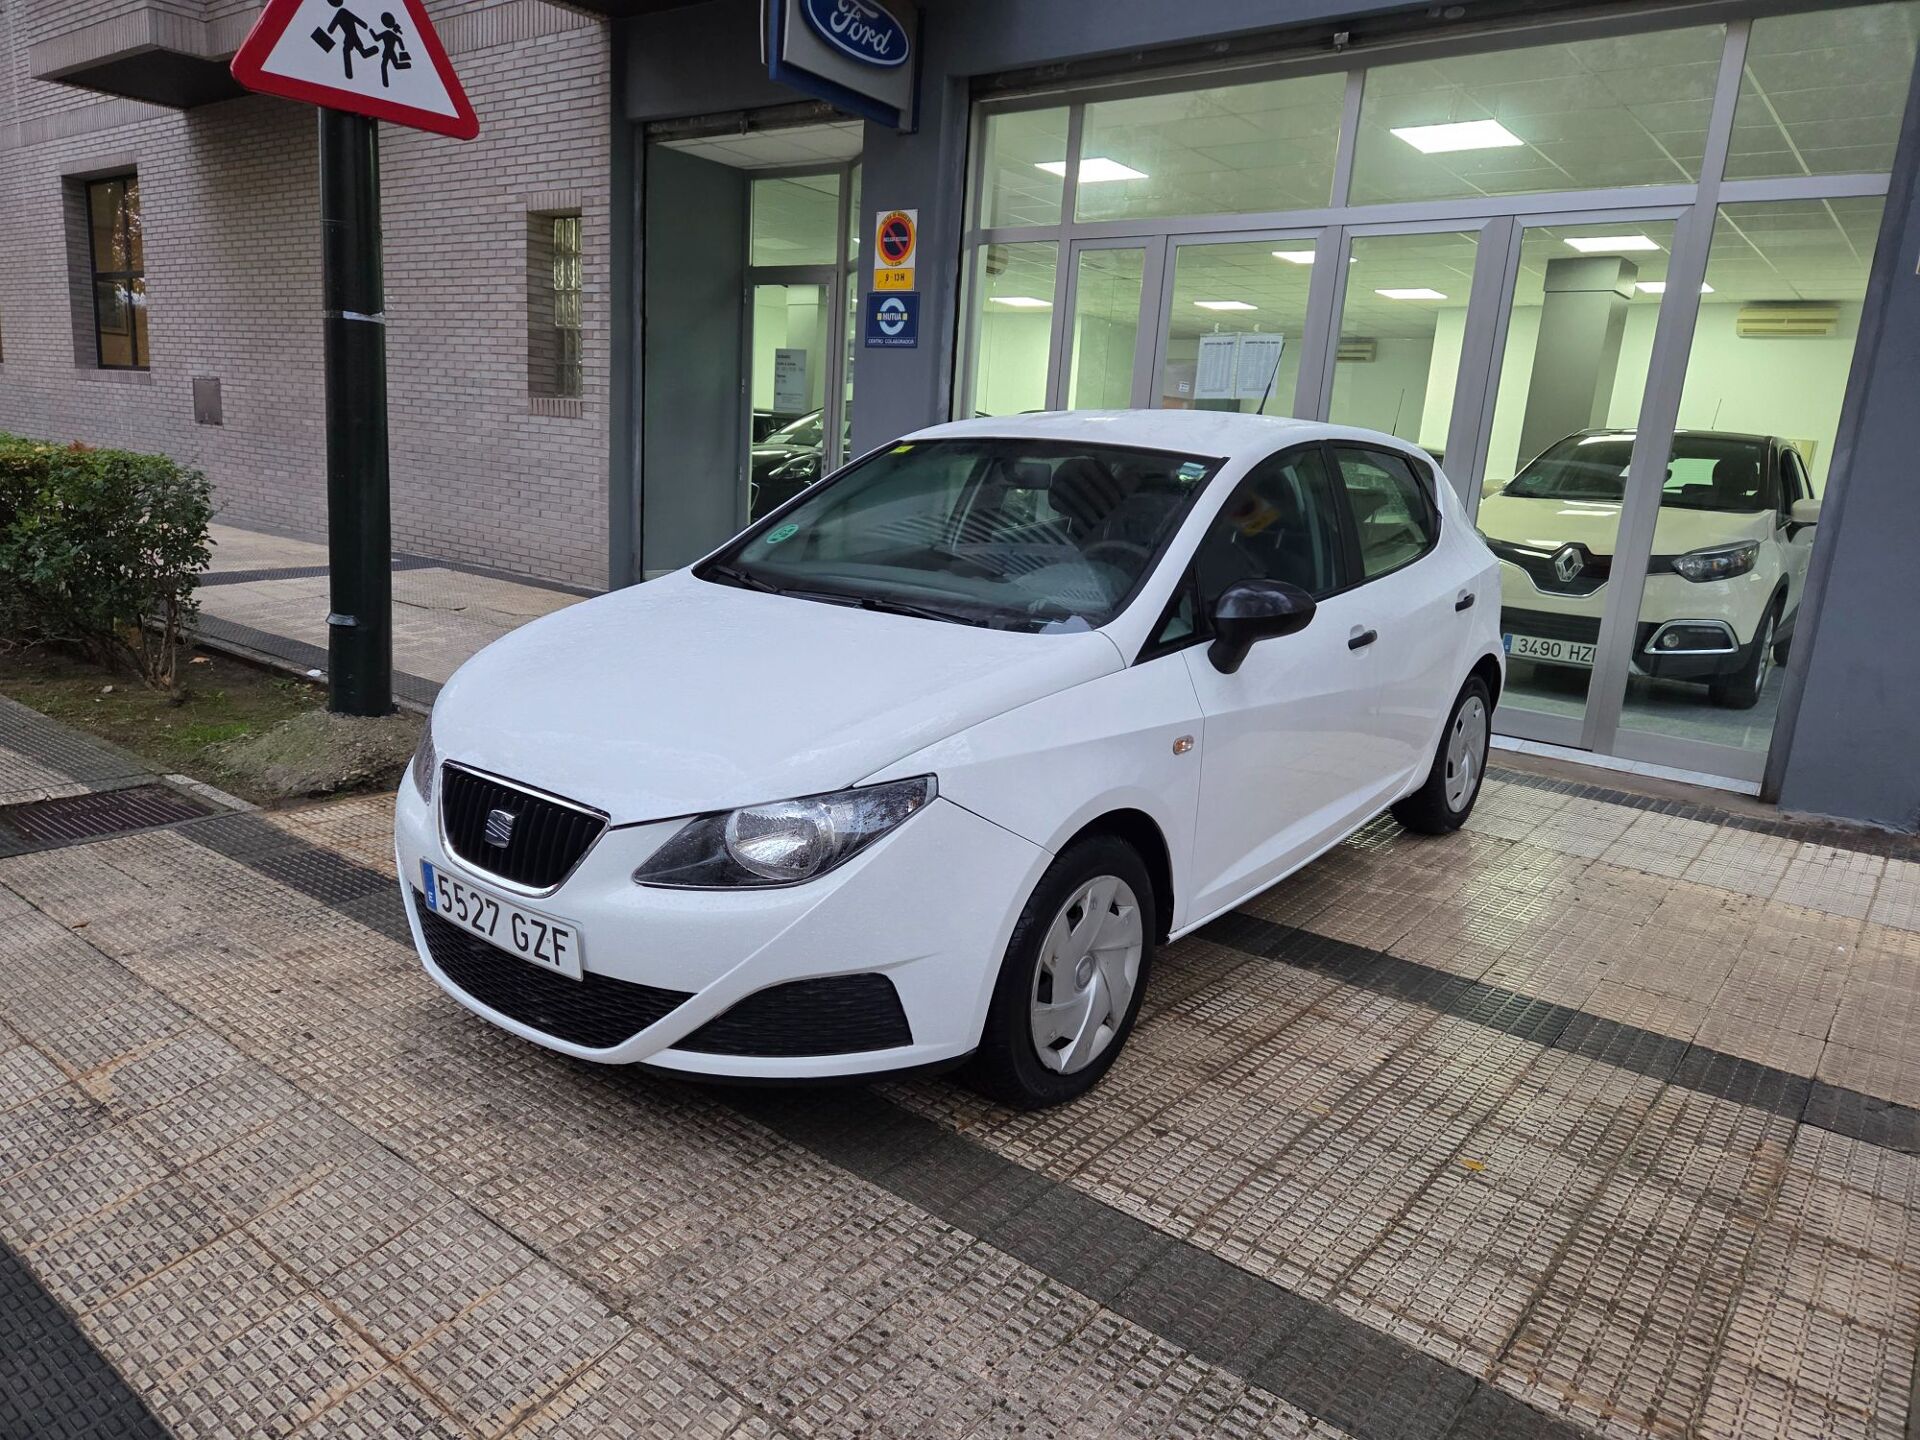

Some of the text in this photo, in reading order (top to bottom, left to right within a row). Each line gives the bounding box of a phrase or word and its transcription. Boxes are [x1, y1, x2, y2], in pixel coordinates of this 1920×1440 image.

[830, 0, 892, 54] Ford
[1518, 638, 1561, 657] 3490
[437, 874, 569, 967] 5527 GZF
